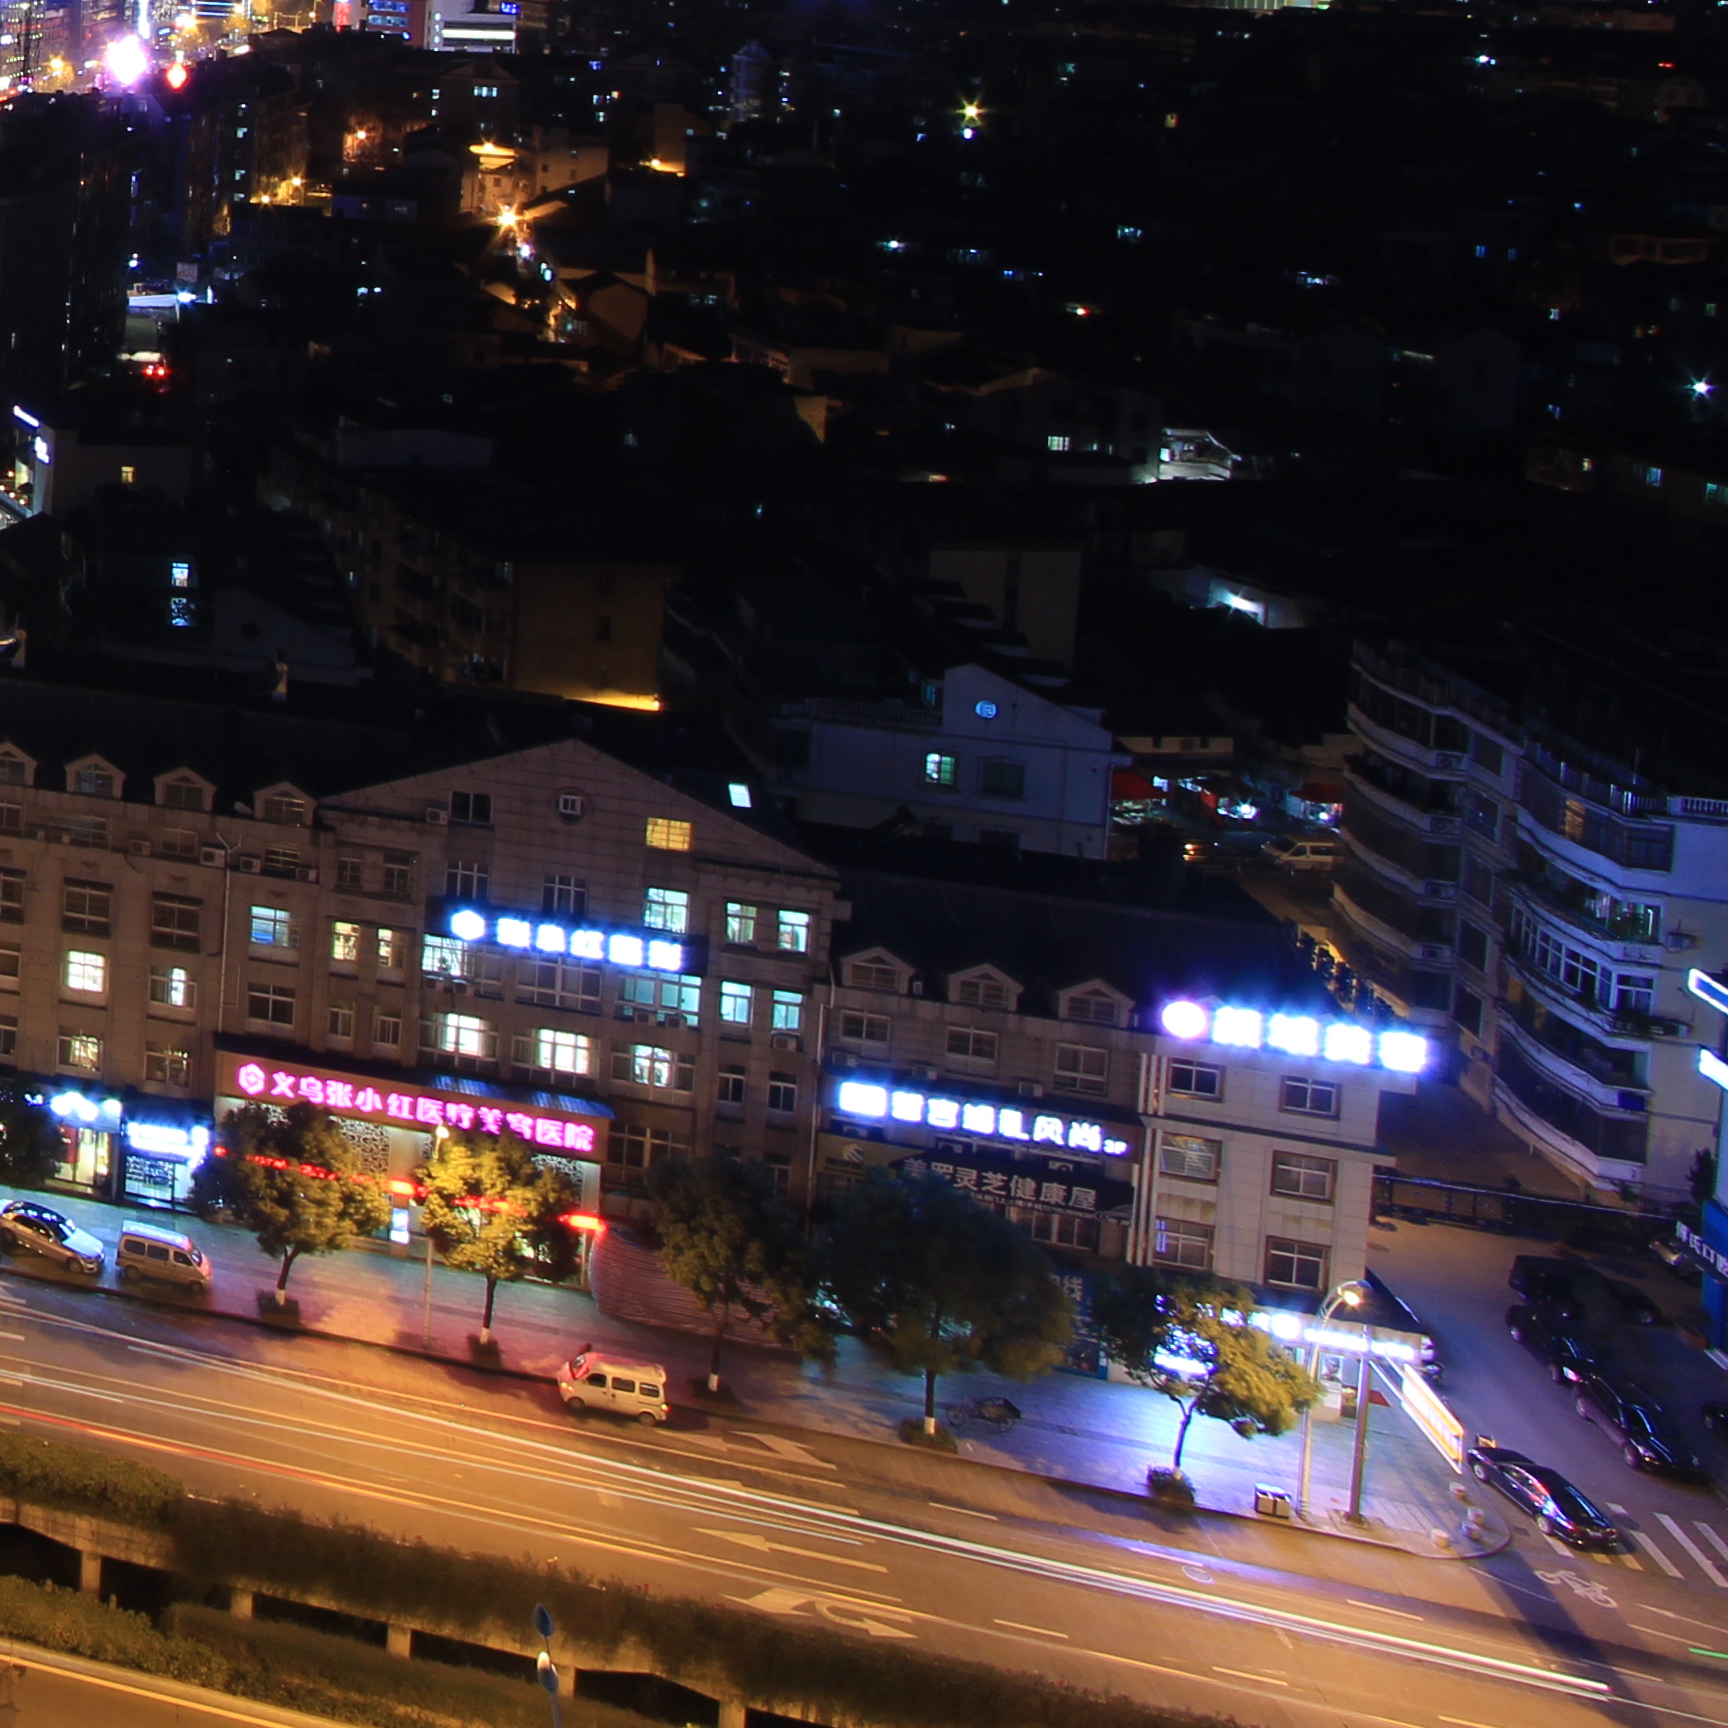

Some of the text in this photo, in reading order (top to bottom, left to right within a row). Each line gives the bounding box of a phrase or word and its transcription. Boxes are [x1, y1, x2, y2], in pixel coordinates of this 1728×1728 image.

[271, 1071, 595, 1153] 义乌张小红医疗美容医院
